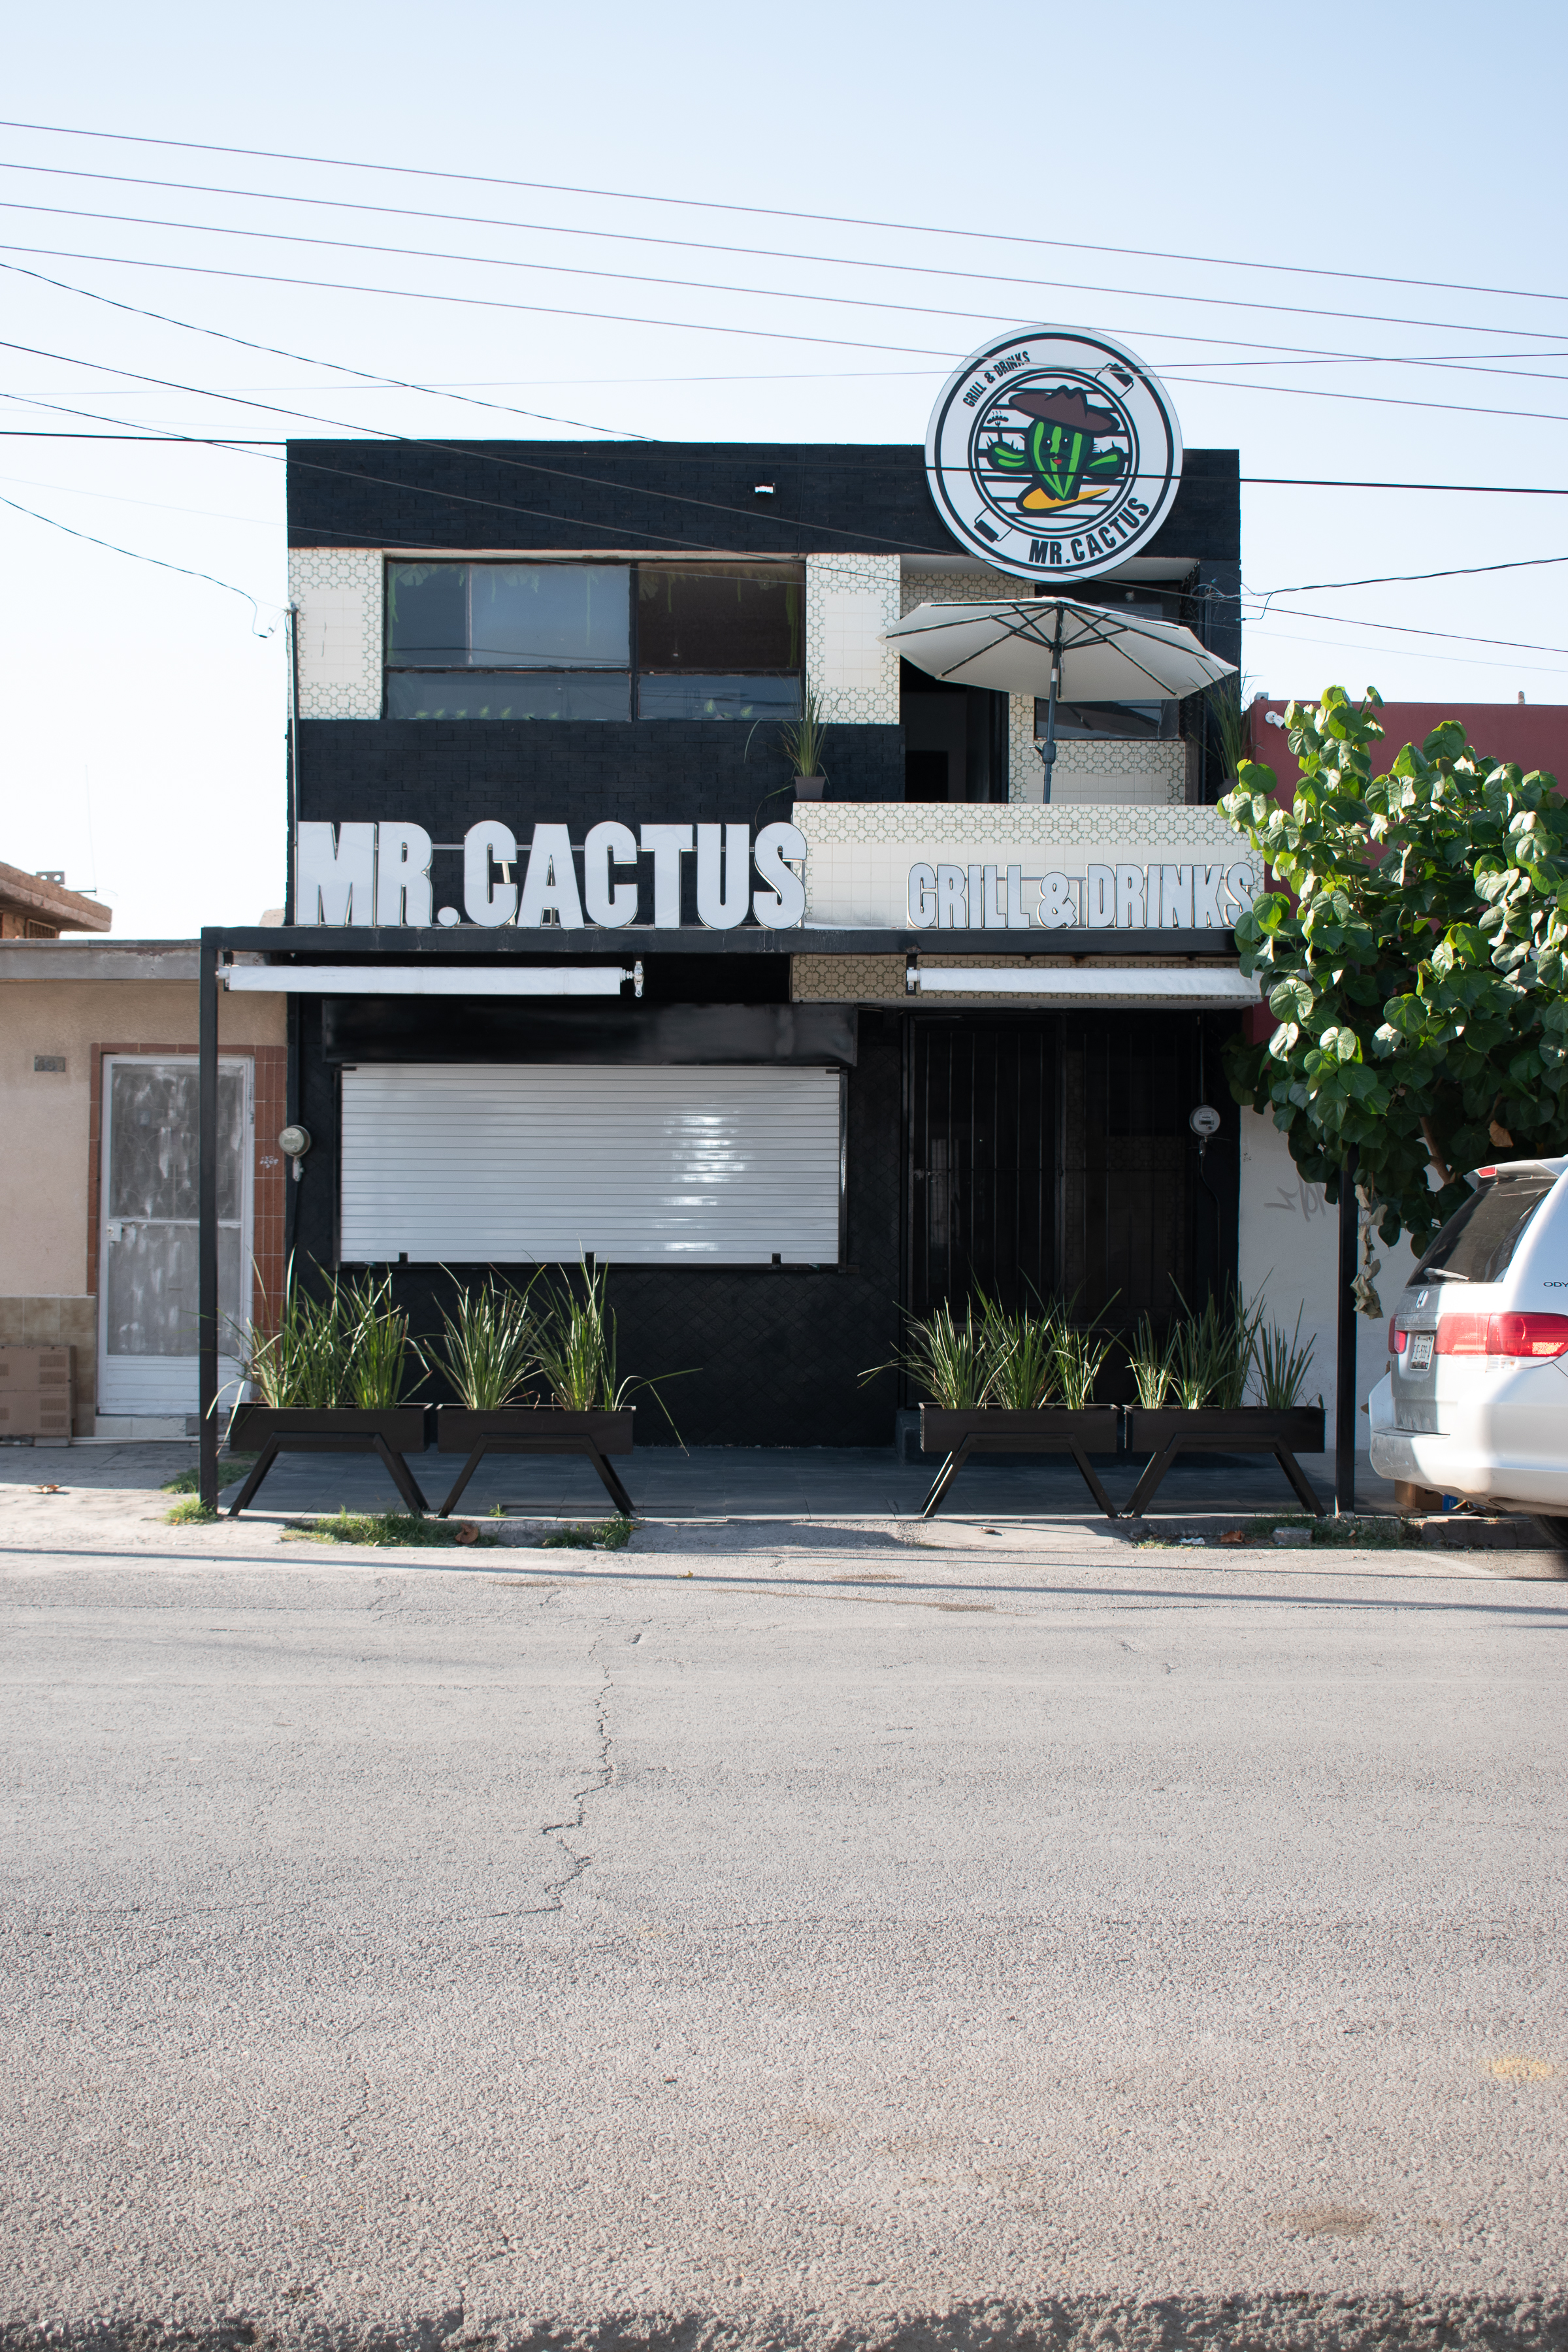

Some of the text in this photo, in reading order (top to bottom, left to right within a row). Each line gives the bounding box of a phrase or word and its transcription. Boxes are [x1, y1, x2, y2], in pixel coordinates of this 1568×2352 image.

[963, 351, 1030, 408] GRILL & DRINKS
[1028, 497, 1149, 564] MR.CACTUS
[297, 821, 808, 929] MR.CACTUS
[907, 862, 1254, 929] GRILL & DRINKS
